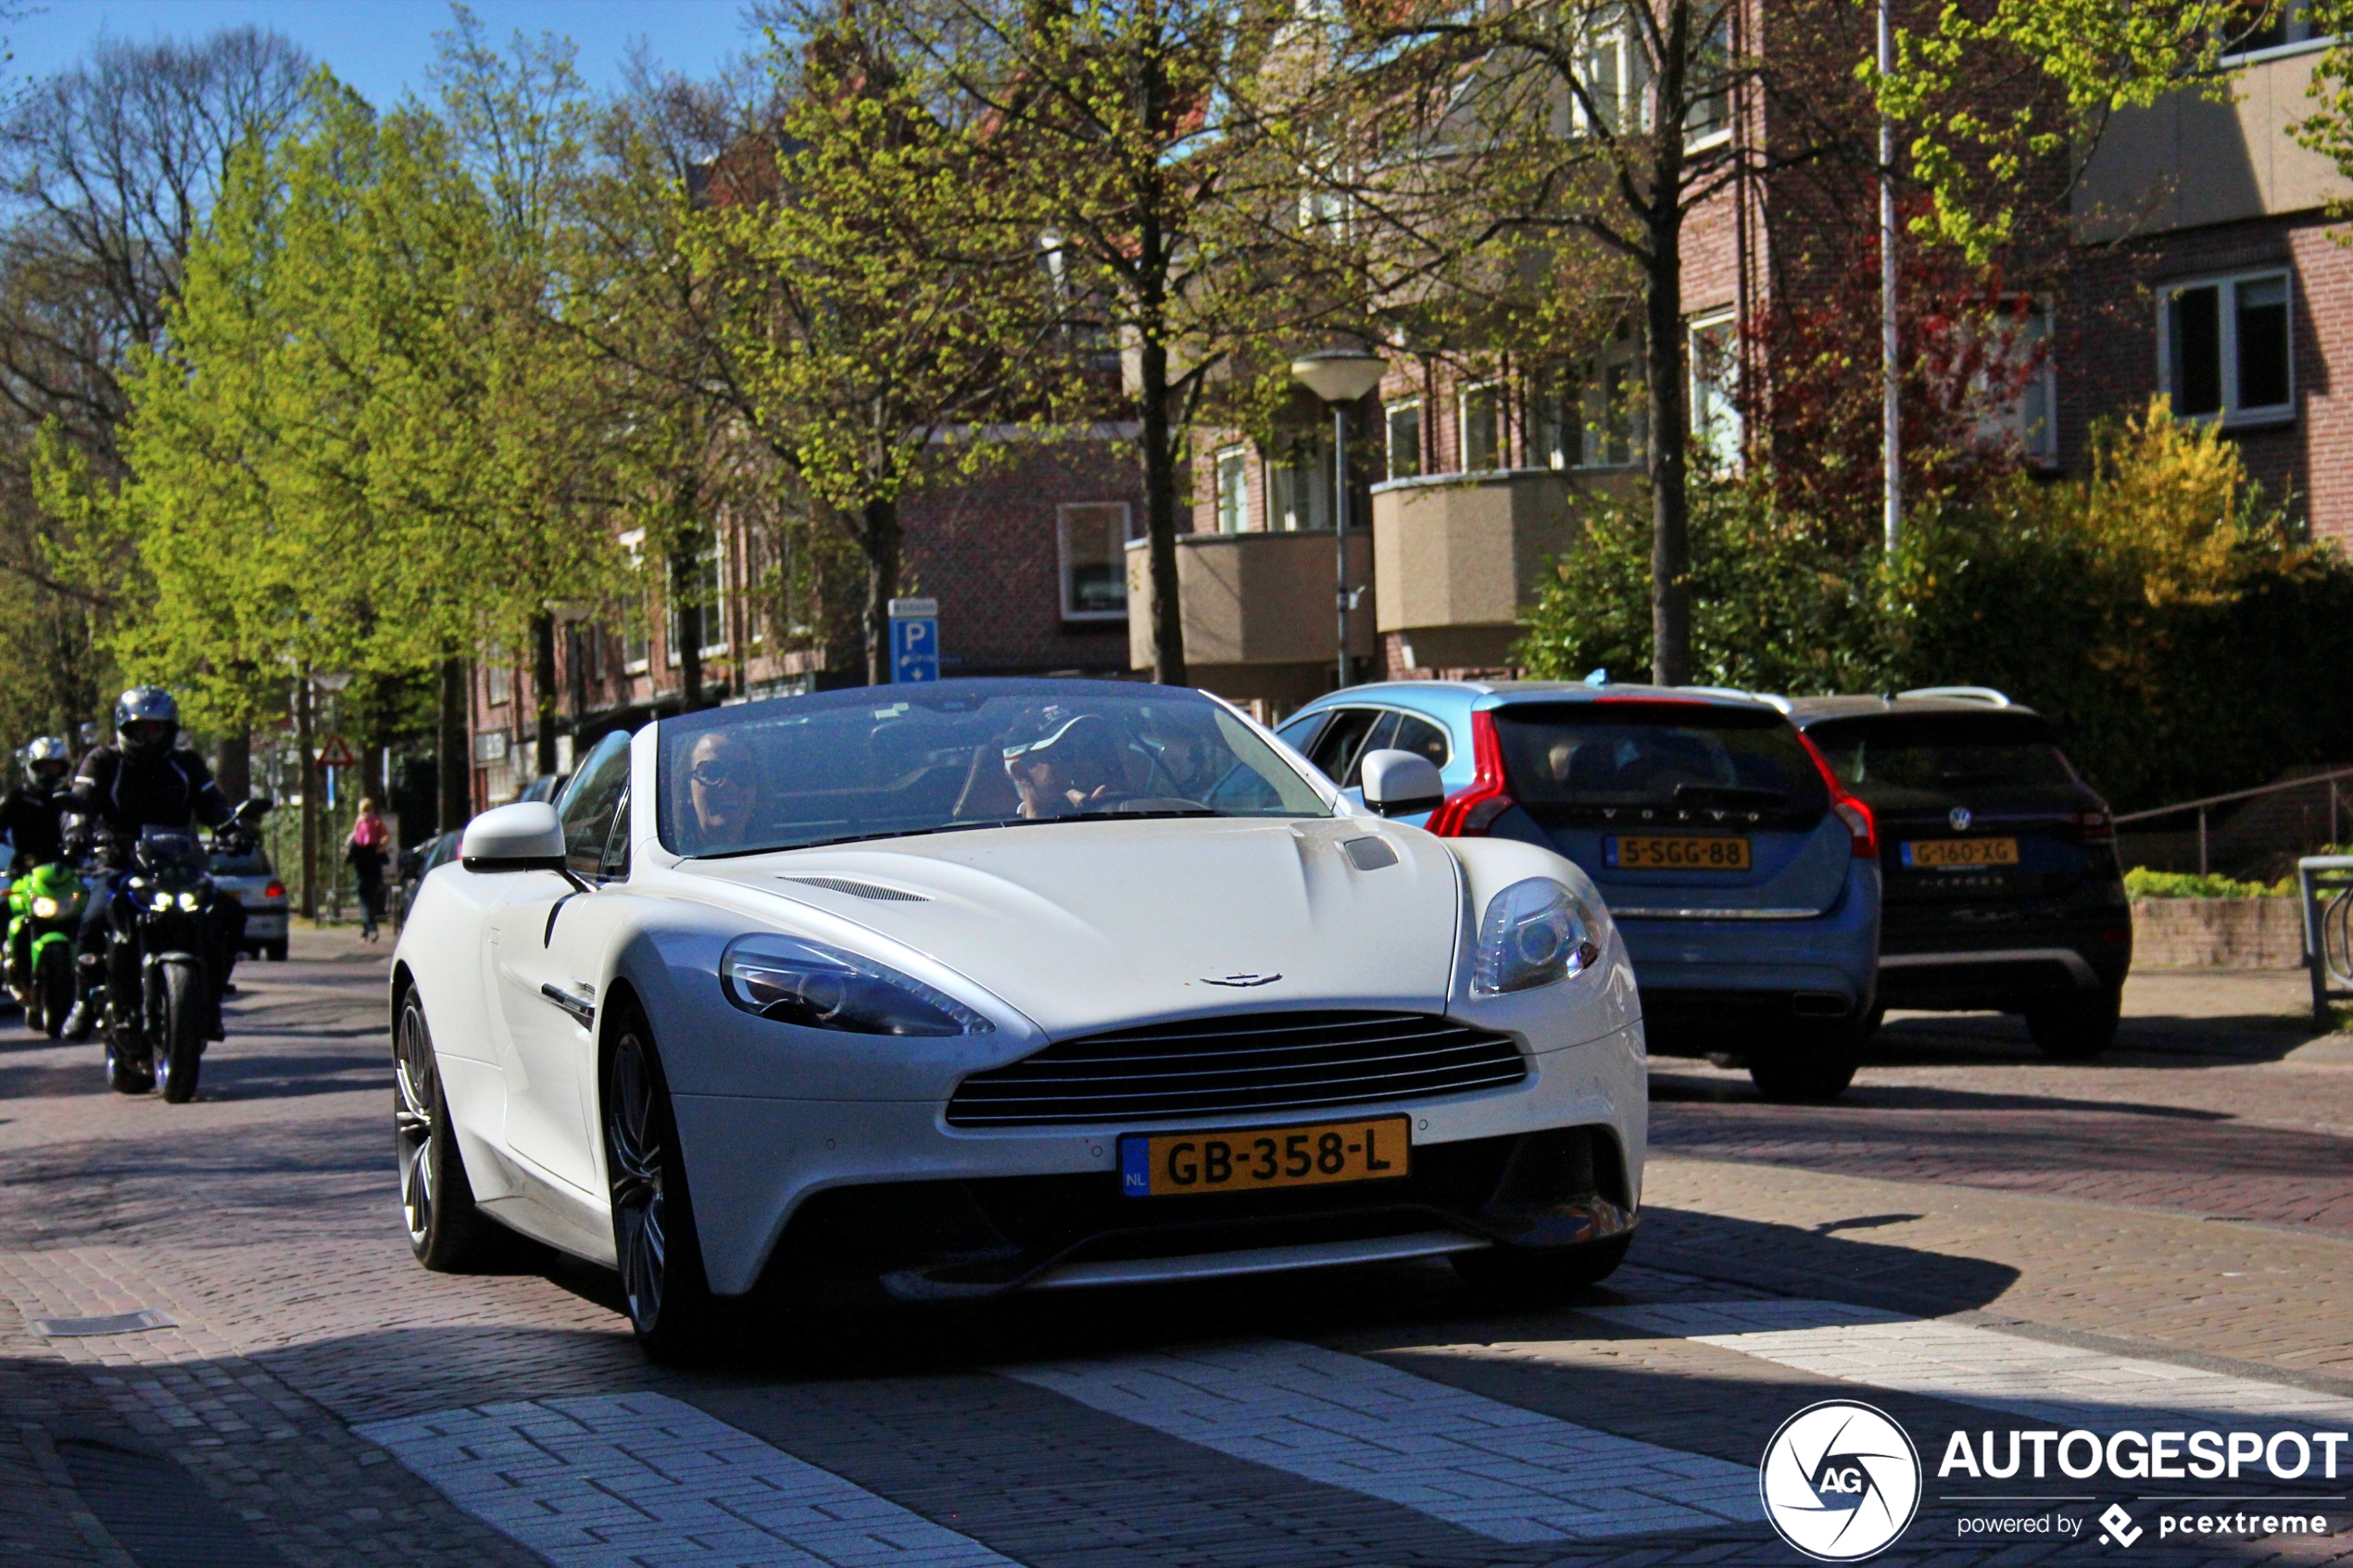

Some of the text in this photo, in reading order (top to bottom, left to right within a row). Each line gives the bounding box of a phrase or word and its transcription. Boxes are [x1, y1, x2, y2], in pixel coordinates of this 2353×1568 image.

[906, 623, 926, 650] P
[1603, 809, 1760, 822] VOLVO
[1625, 840, 1741, 864] 5-SGG-88
[1918, 842, 2008, 863] G-160-XG
[1168, 1129, 1390, 1185] GB-358-L
[1126, 1173, 1146, 1186] NL
